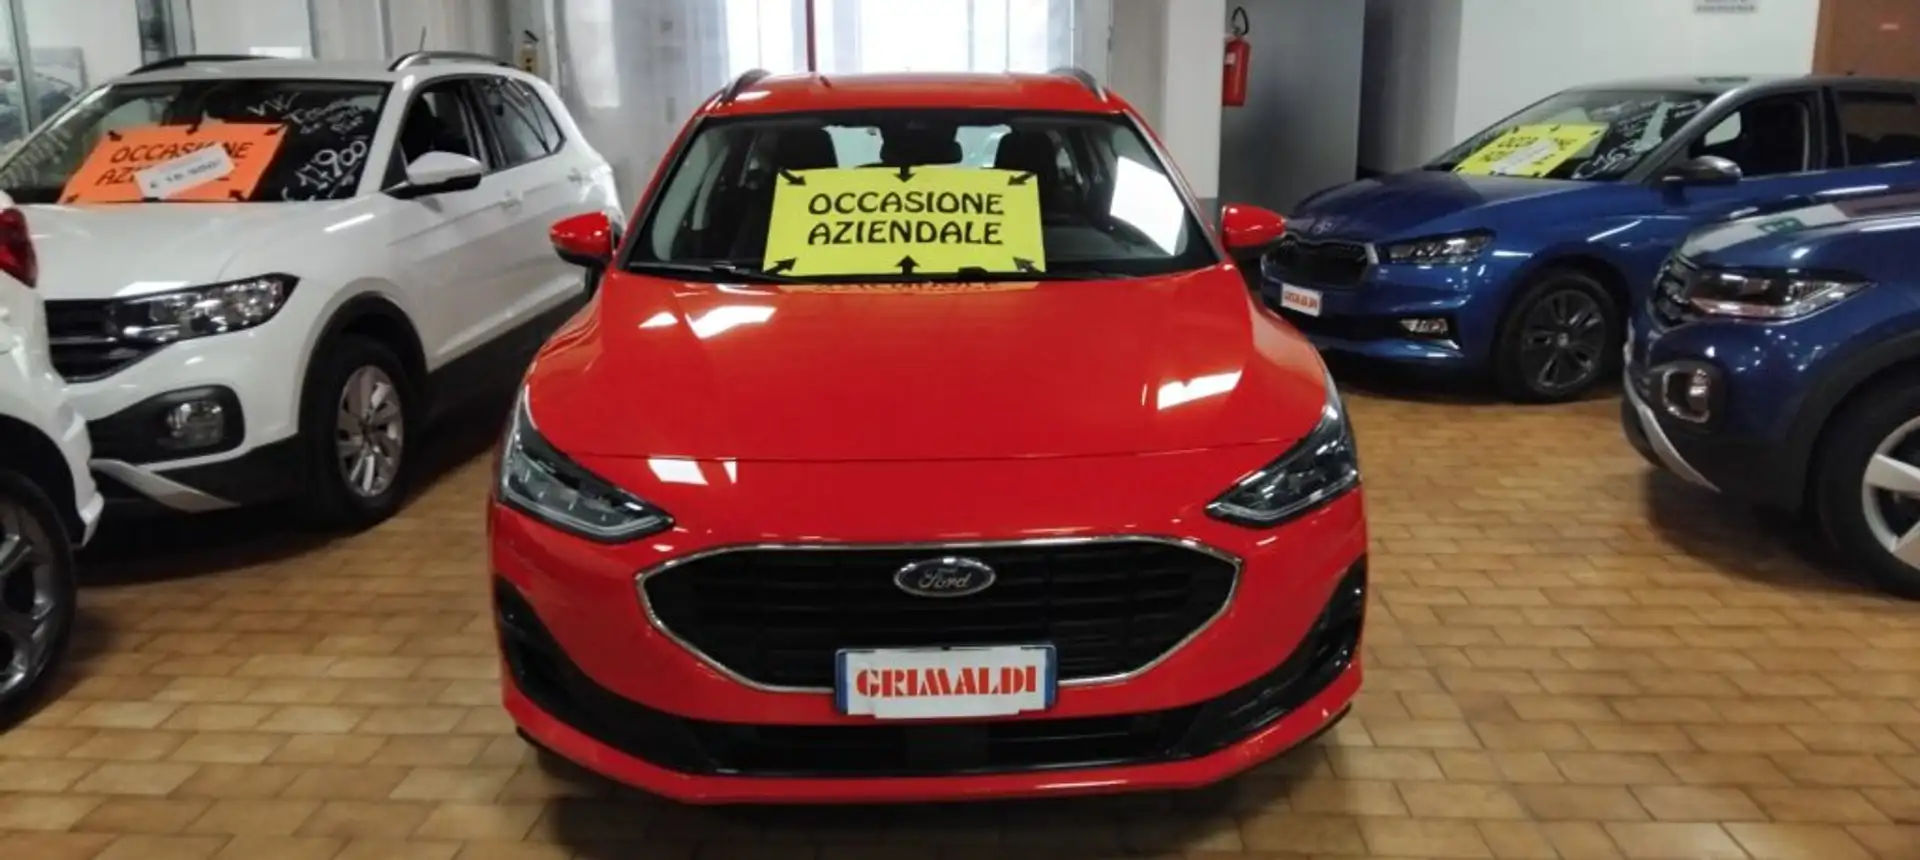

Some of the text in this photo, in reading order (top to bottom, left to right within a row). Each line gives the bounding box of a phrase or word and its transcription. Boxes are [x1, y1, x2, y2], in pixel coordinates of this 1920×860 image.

[807, 191, 1004, 216] OCCASIONE
[807, 220, 1004, 246] AZIENDALE
[918, 568, 972, 589] Ford
[856, 665, 1037, 699] GRIMALDI
